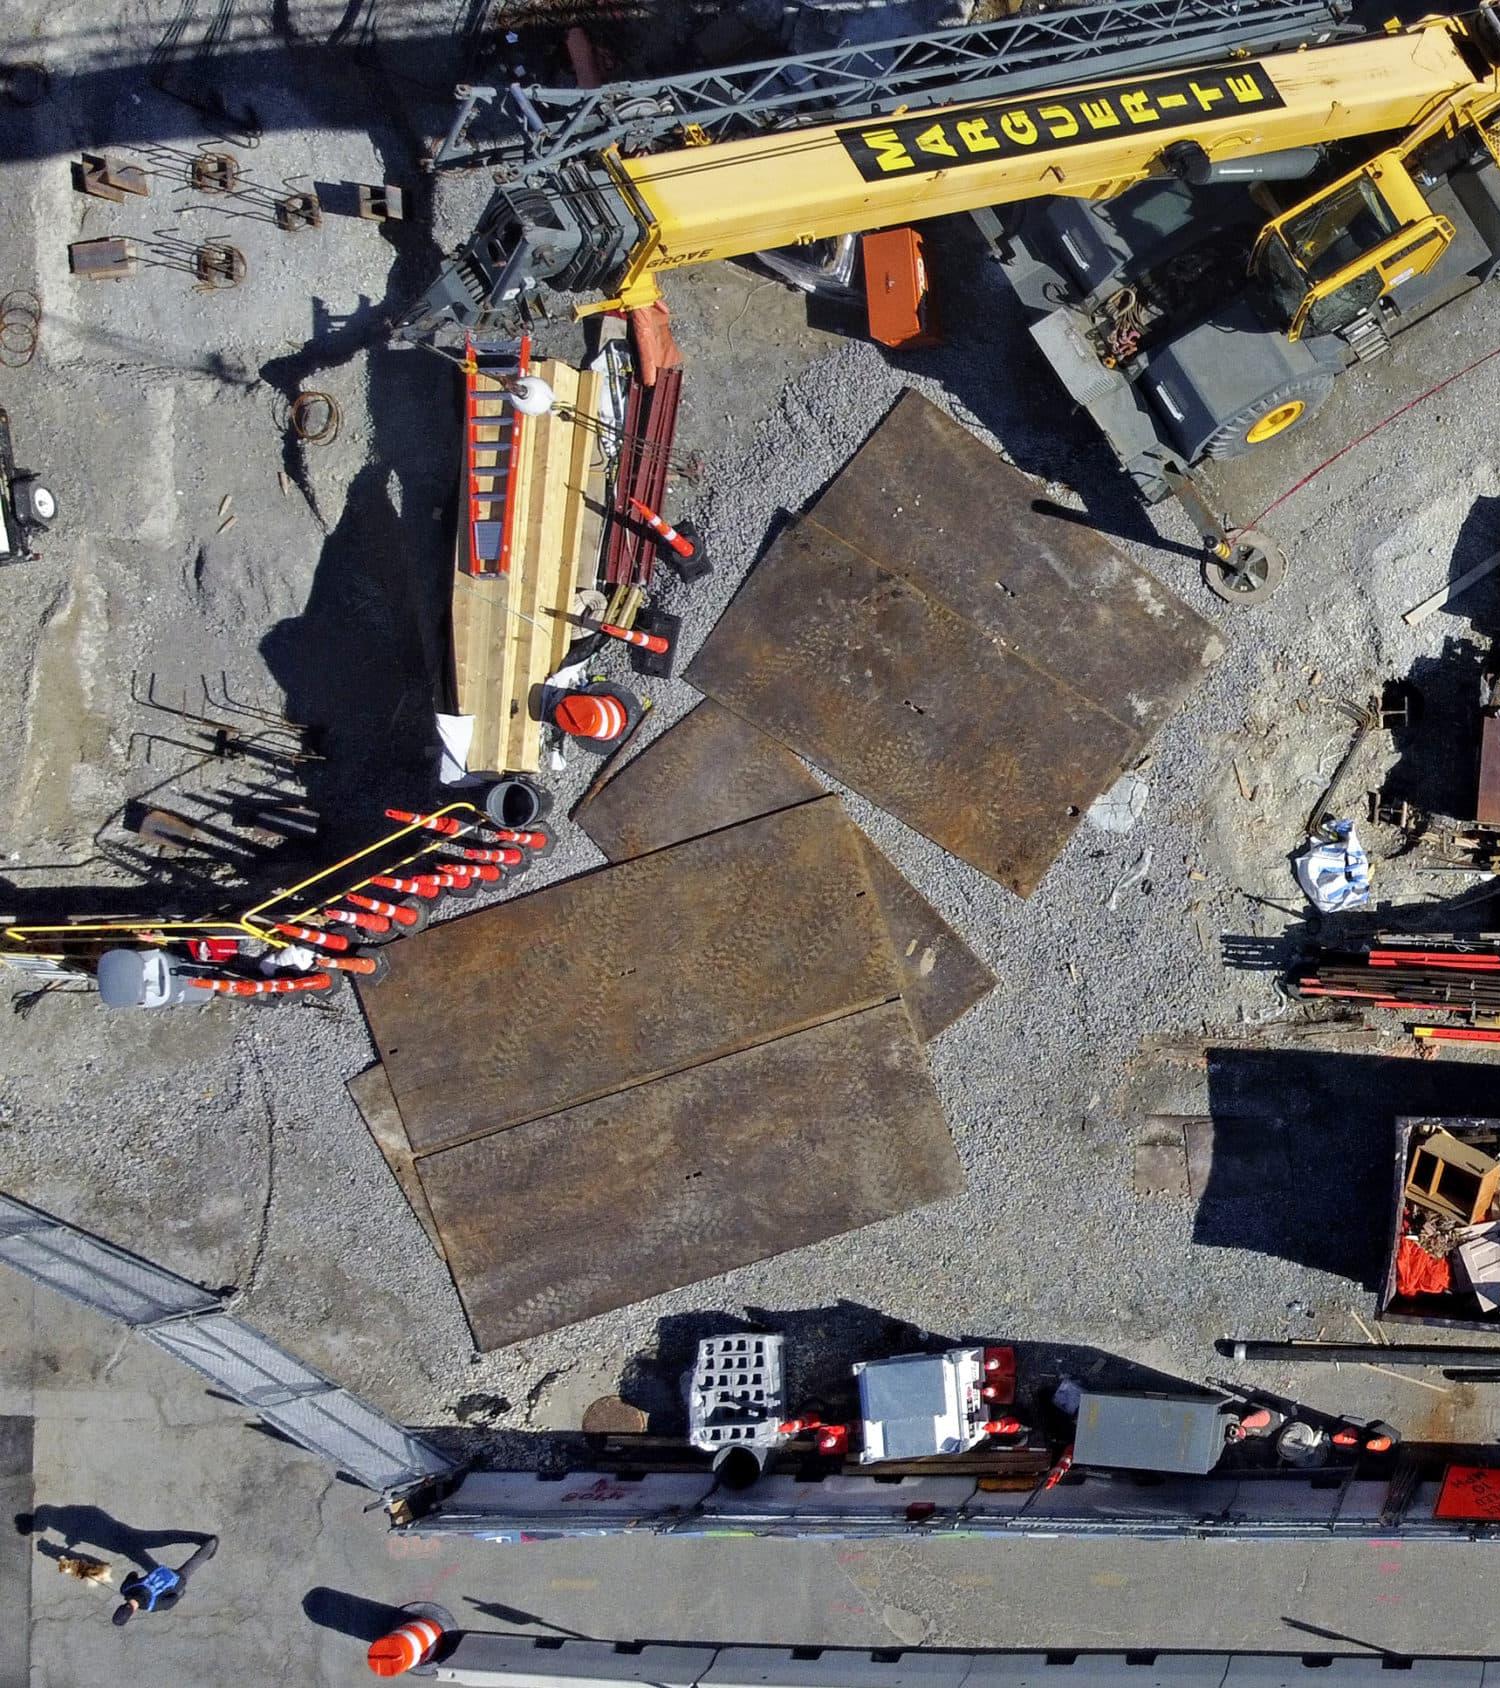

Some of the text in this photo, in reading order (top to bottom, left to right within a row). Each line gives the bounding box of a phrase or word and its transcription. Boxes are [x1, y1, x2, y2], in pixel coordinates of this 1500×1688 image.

[862, 73, 1264, 172] MARGUERITE
[646, 248, 714, 268] GROVE
[1451, 1471, 1487, 1488] MPH
[1472, 1481, 1493, 1494] 10
